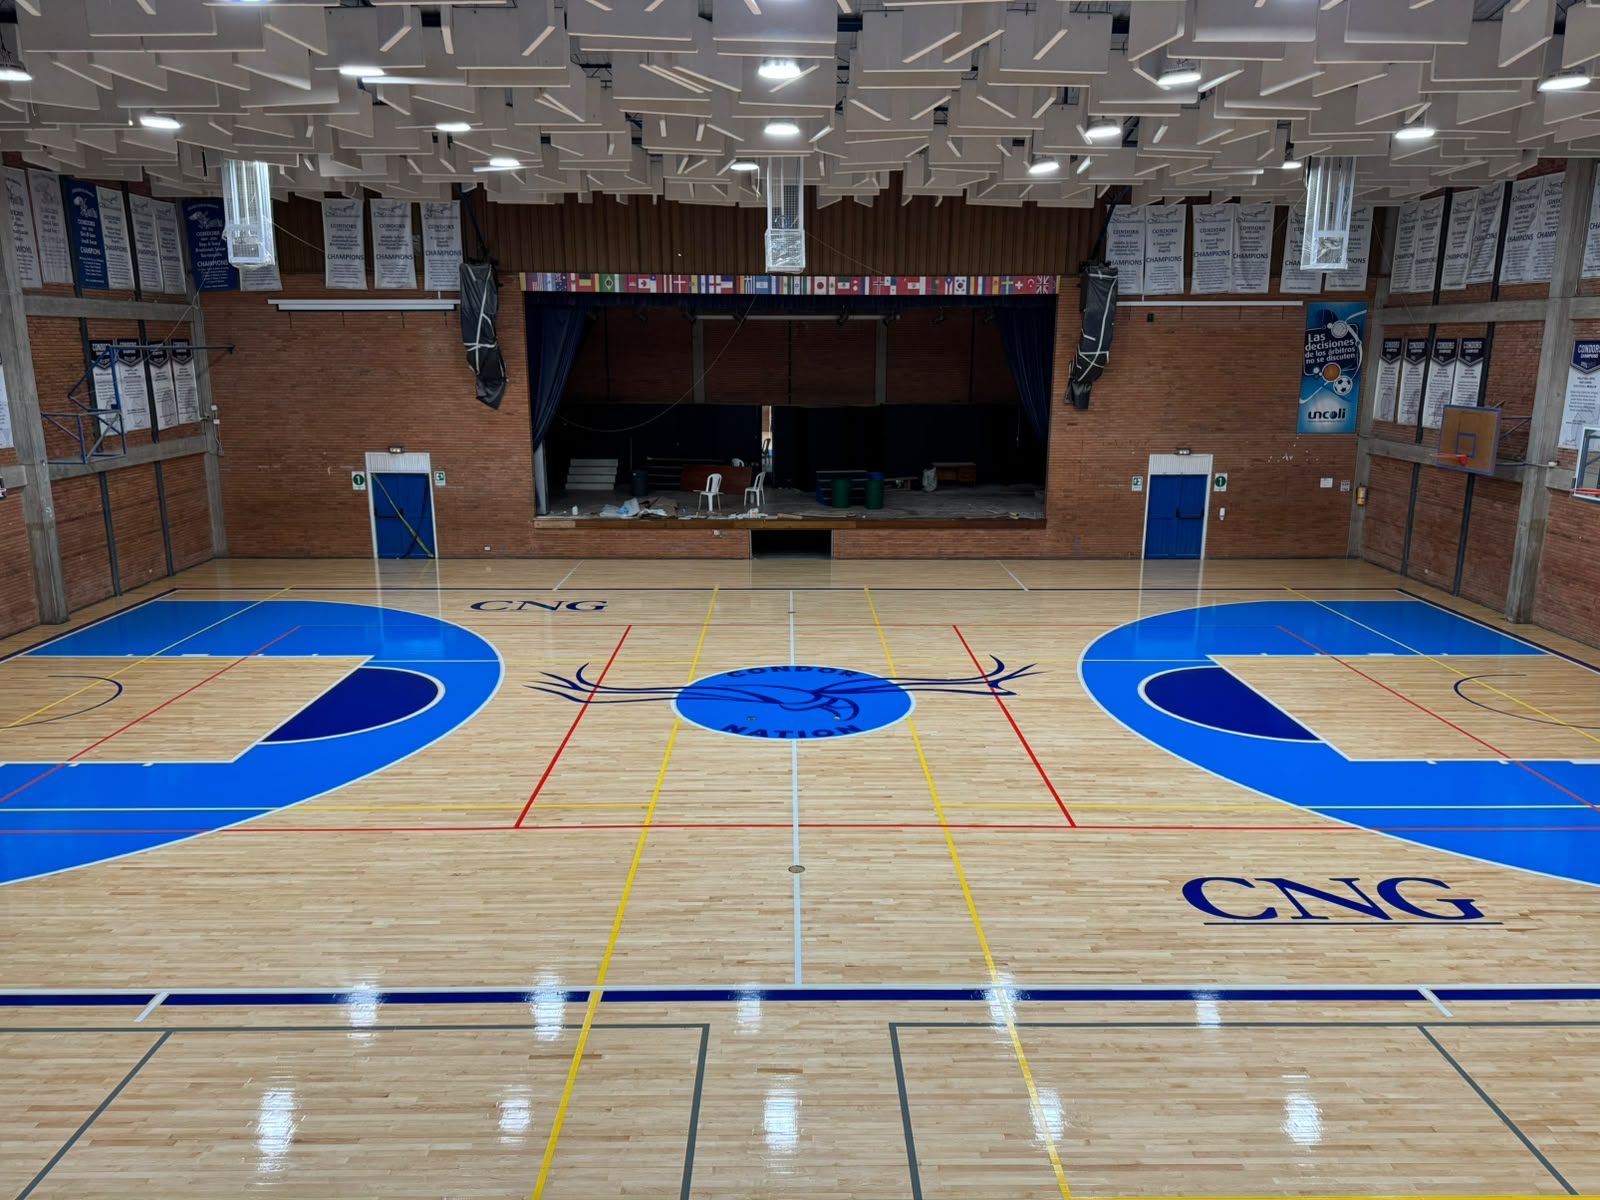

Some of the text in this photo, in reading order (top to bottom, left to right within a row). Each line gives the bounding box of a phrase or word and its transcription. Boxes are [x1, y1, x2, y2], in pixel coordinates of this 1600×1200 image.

[1194, 249, 1230, 258] CHAMPIONS
[1146, 255, 1182, 263] CHAMPIONS
[1307, 333, 1326, 343] Las
[1305, 338, 1355, 351] decisiones
[1305, 351, 1314, 359] de
[1326, 353, 1355, 362] discuten
[470, 600, 608, 611] CNG
[726, 665, 860, 679] CONDOR
[721, 723, 865, 740] NATION
[1182, 876, 1486, 921] CNG
